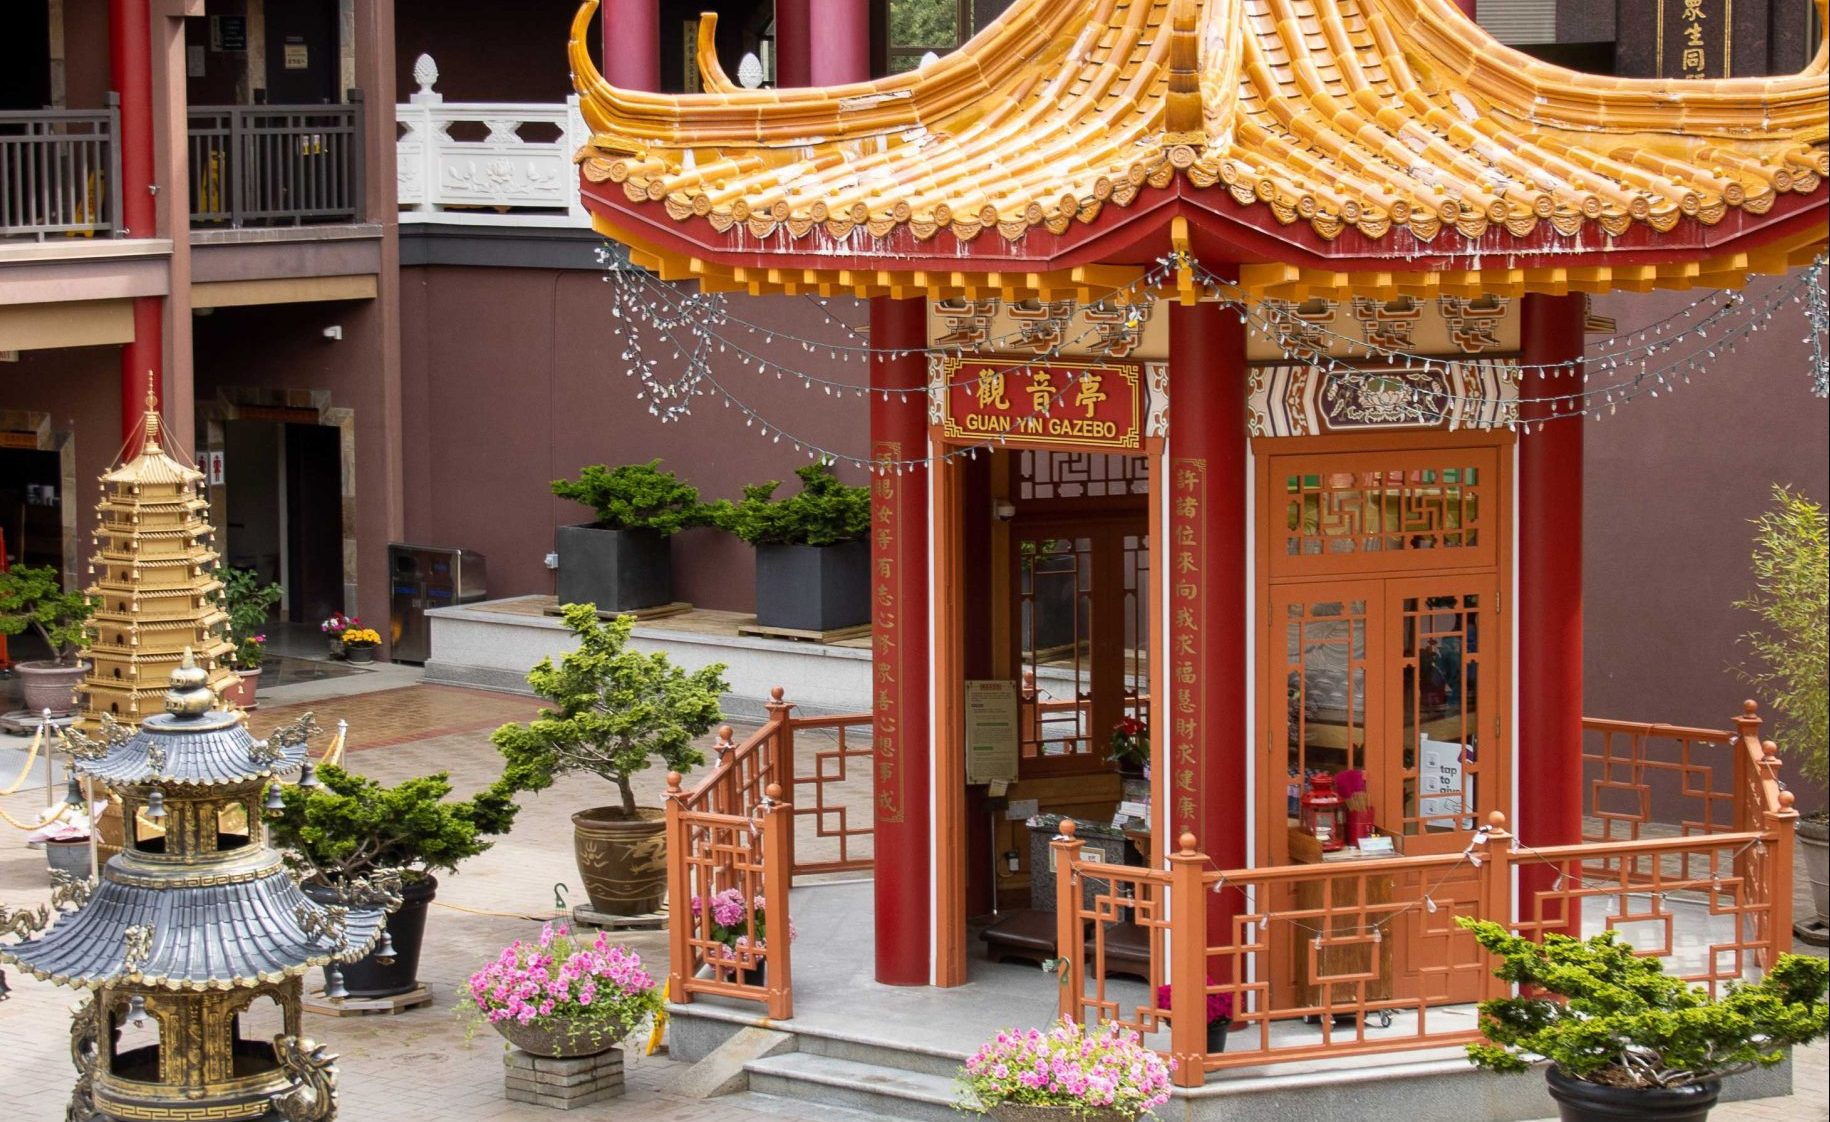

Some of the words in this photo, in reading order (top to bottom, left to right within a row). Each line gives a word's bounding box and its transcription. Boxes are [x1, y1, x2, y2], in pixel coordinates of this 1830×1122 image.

[975, 368, 1107, 418] 觀音亭
[966, 413, 1011, 432] GUAN
[1017, 417, 1043, 434] YIN
[1049, 418, 1117, 438] GAZEBO
[1440, 765, 1457, 776] tap
[1440, 776, 1450, 784] to
